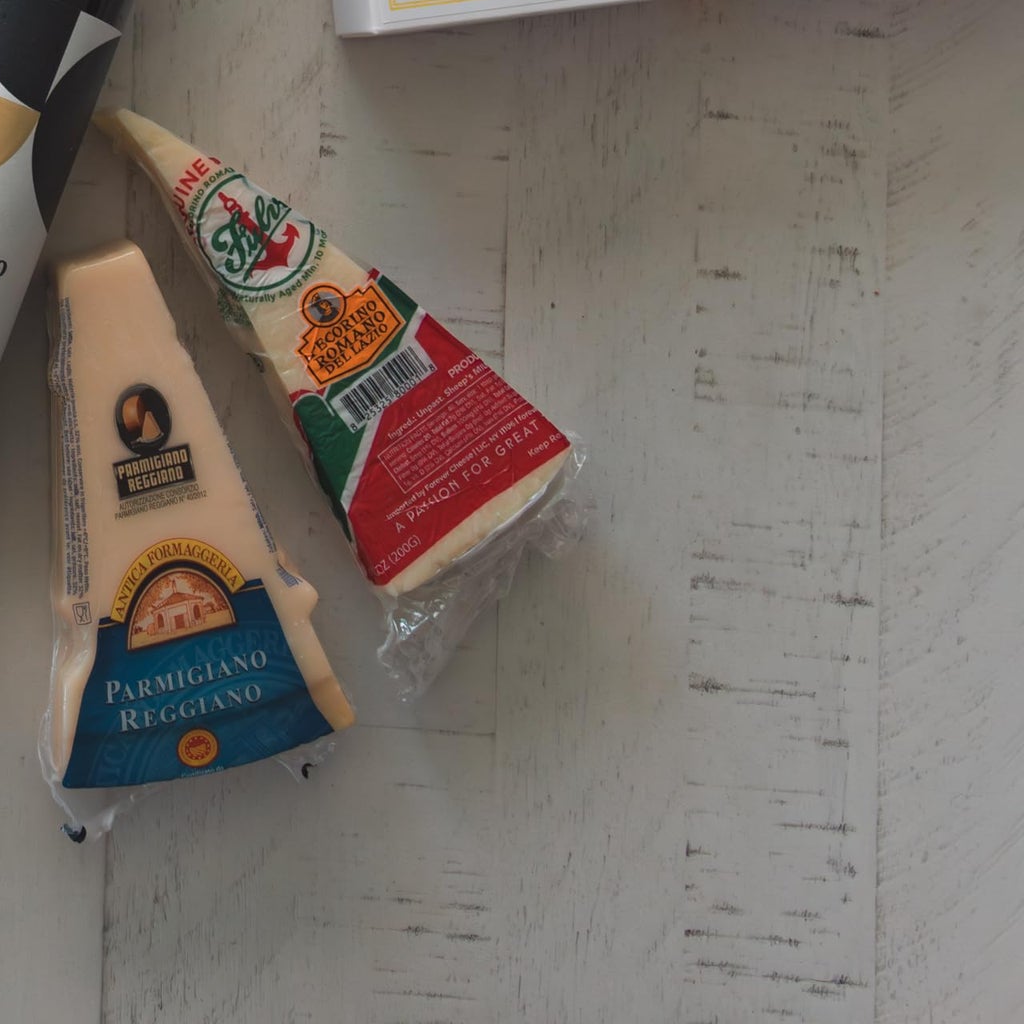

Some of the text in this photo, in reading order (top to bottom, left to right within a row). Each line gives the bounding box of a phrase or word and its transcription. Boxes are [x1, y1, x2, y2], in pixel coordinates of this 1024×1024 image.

[278, 280, 303, 298] Aged
[314, 250, 324, 261] 10
[314, 311, 385, 369] ROMANO
[324, 323, 388, 375] DEL LAZIO
[350, 423, 358, 431] 8
[365, 397, 392, 421] 25325
[428, 363, 436, 372] 8
[443, 373, 474, 397] Sheep's
[117, 449, 188, 479] PARMIGIANO
[386, 494, 417, 520] Imported
[414, 488, 426, 498] by
[424, 470, 450, 491] Forever
[449, 452, 474, 473] Cheese
[488, 432, 499, 443] NY
[498, 420, 516, 435] 11106
[527, 440, 550, 457] Keep
[127, 466, 184, 492] REGGIANO
[395, 522, 406, 533] A
[462, 456, 492, 482] FOR
[495, 419, 539, 456] GREAT
[387, 534, 421, 565] (200G)
[115, 563, 147, 617] ANTICA
[147, 542, 239, 587] FORMAGGERIA
[106, 650, 267, 704] PARMIGIANO
[120, 684, 261, 732] REGGIANO
